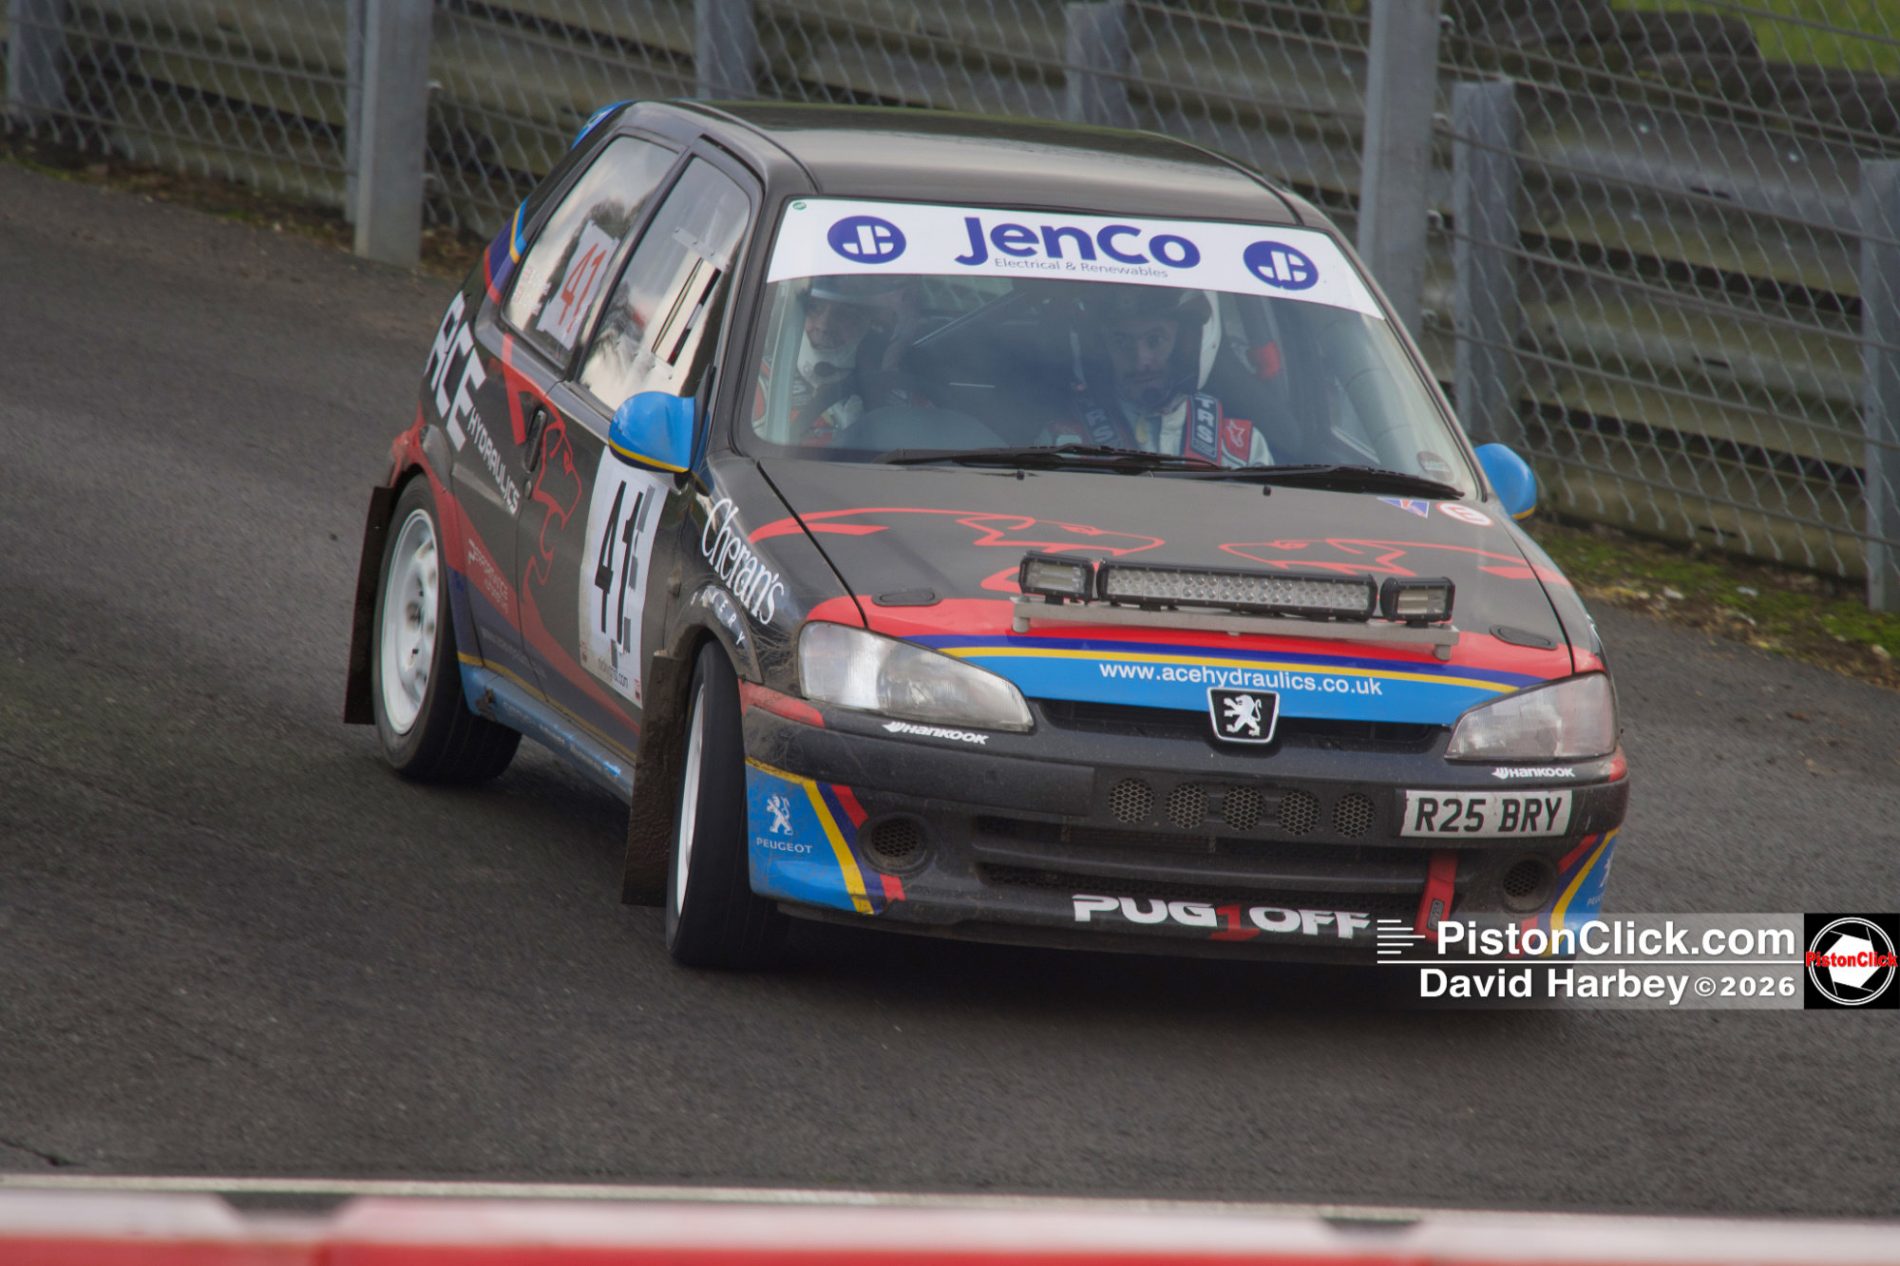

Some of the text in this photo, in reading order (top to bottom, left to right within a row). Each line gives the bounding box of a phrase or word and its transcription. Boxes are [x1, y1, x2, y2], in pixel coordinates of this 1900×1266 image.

[954, 216, 1201, 269] JenCo
[994, 257, 1169, 279] Electrical & Renewables
[558, 243, 608, 334] 41
[424, 290, 487, 452] ACE
[467, 407, 521, 515] HYDRAULICS
[702, 498, 785, 625] Cheran's
[1099, 662, 1384, 696] www.acehydraulics.co.uk
[1415, 797, 1563, 833] R25 BRY
[756, 837, 813, 854] PEUGEOT
